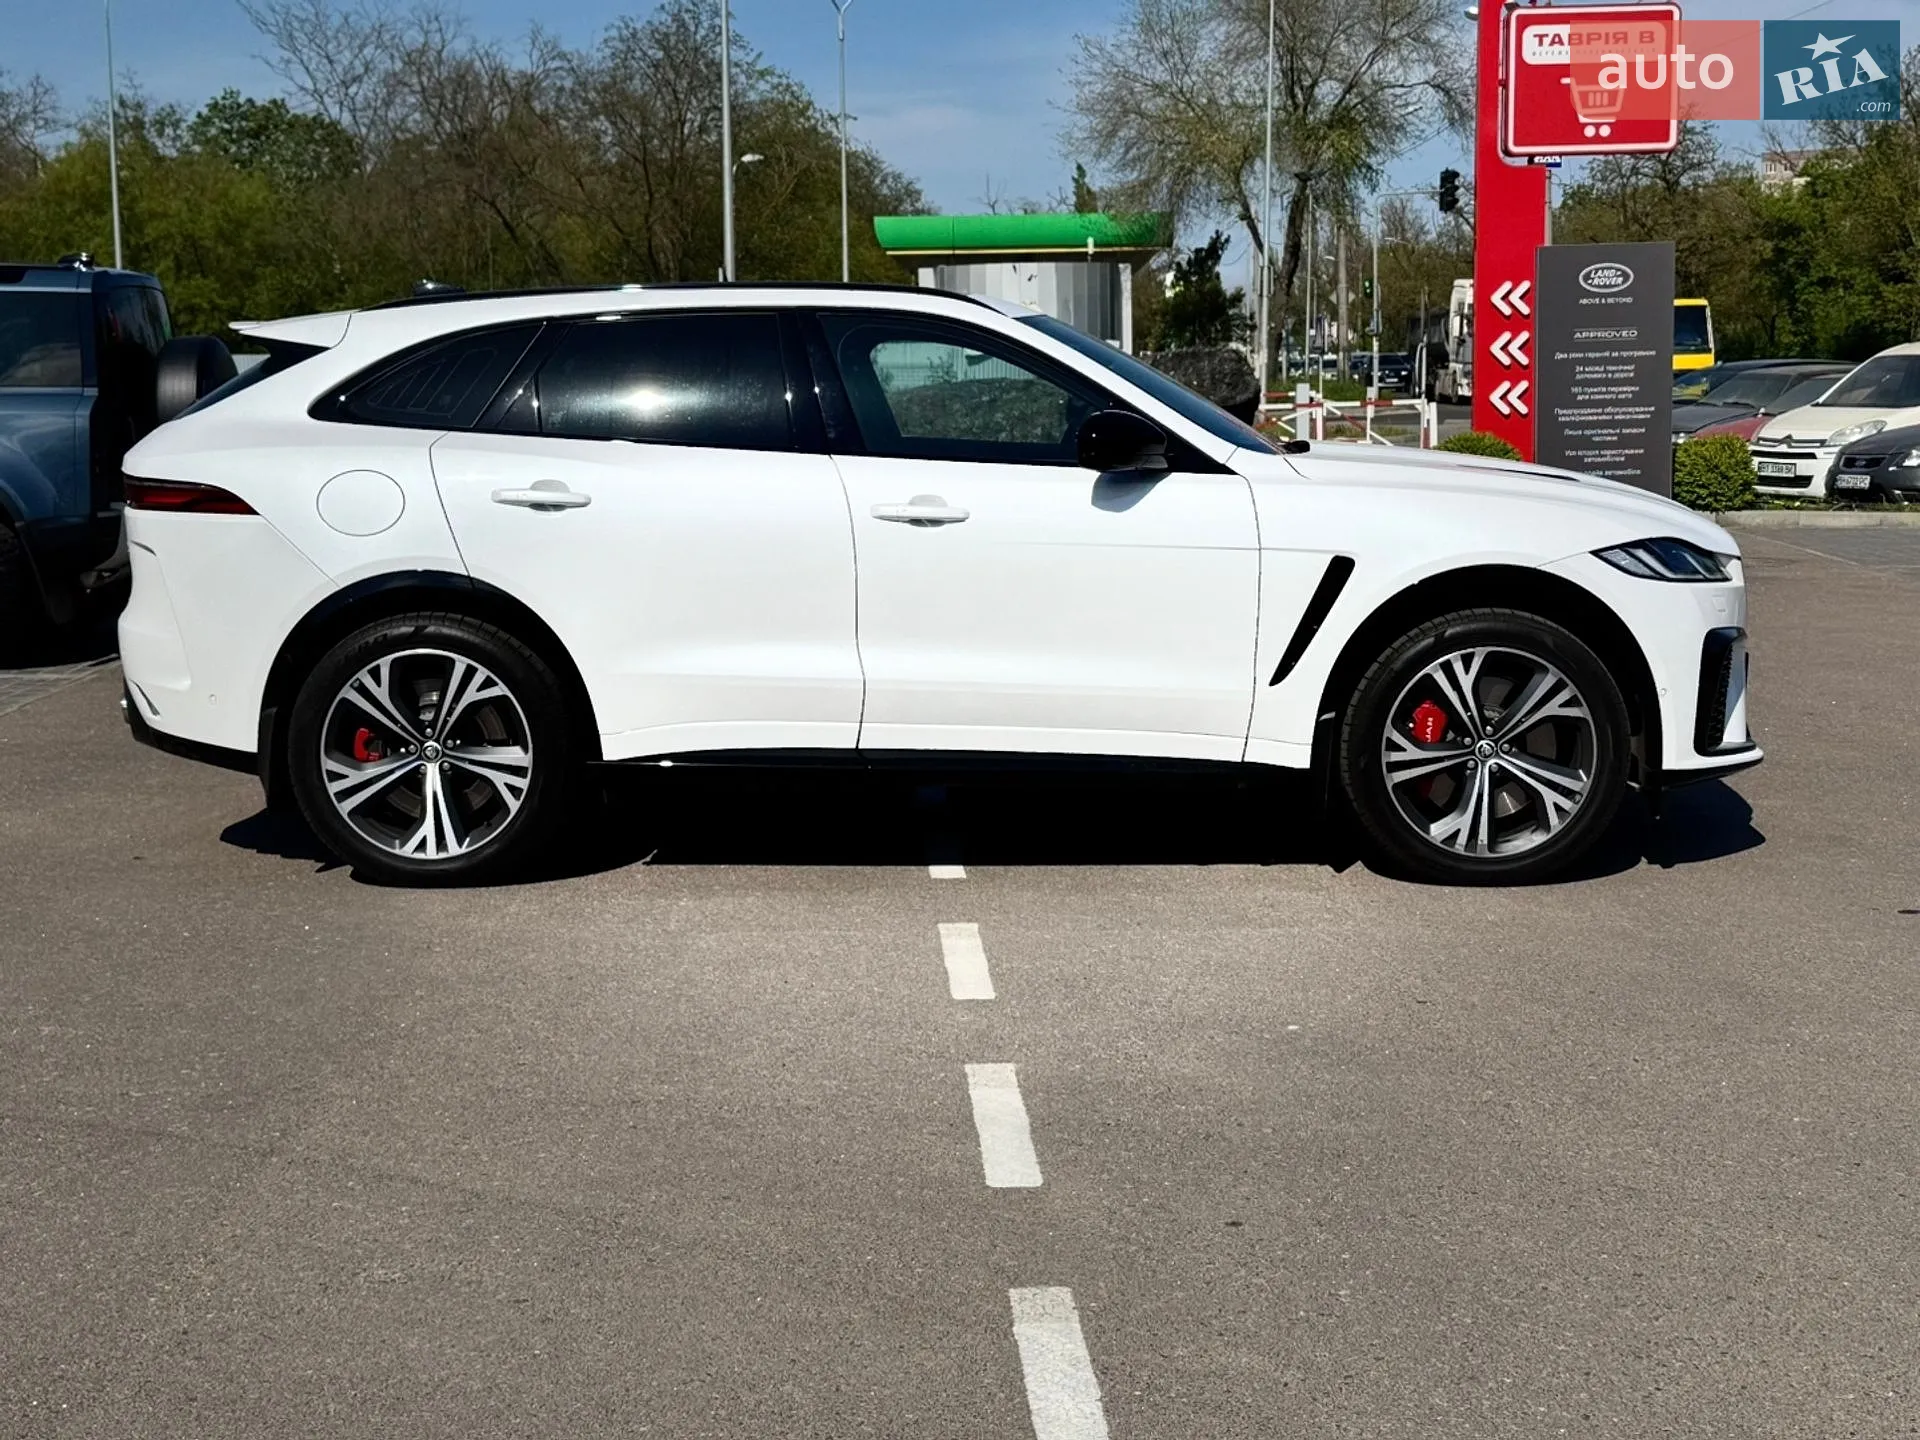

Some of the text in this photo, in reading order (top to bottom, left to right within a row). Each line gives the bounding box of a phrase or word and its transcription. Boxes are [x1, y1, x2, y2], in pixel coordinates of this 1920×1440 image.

[1532, 30, 1655, 47] ТАВРІЯ В
[1590, 269, 1616, 278] LAND
[1592, 277, 1623, 285] ROVER
[1606, 296, 1633, 304] BEYOND
[1573, 330, 1638, 339] APPROVED
